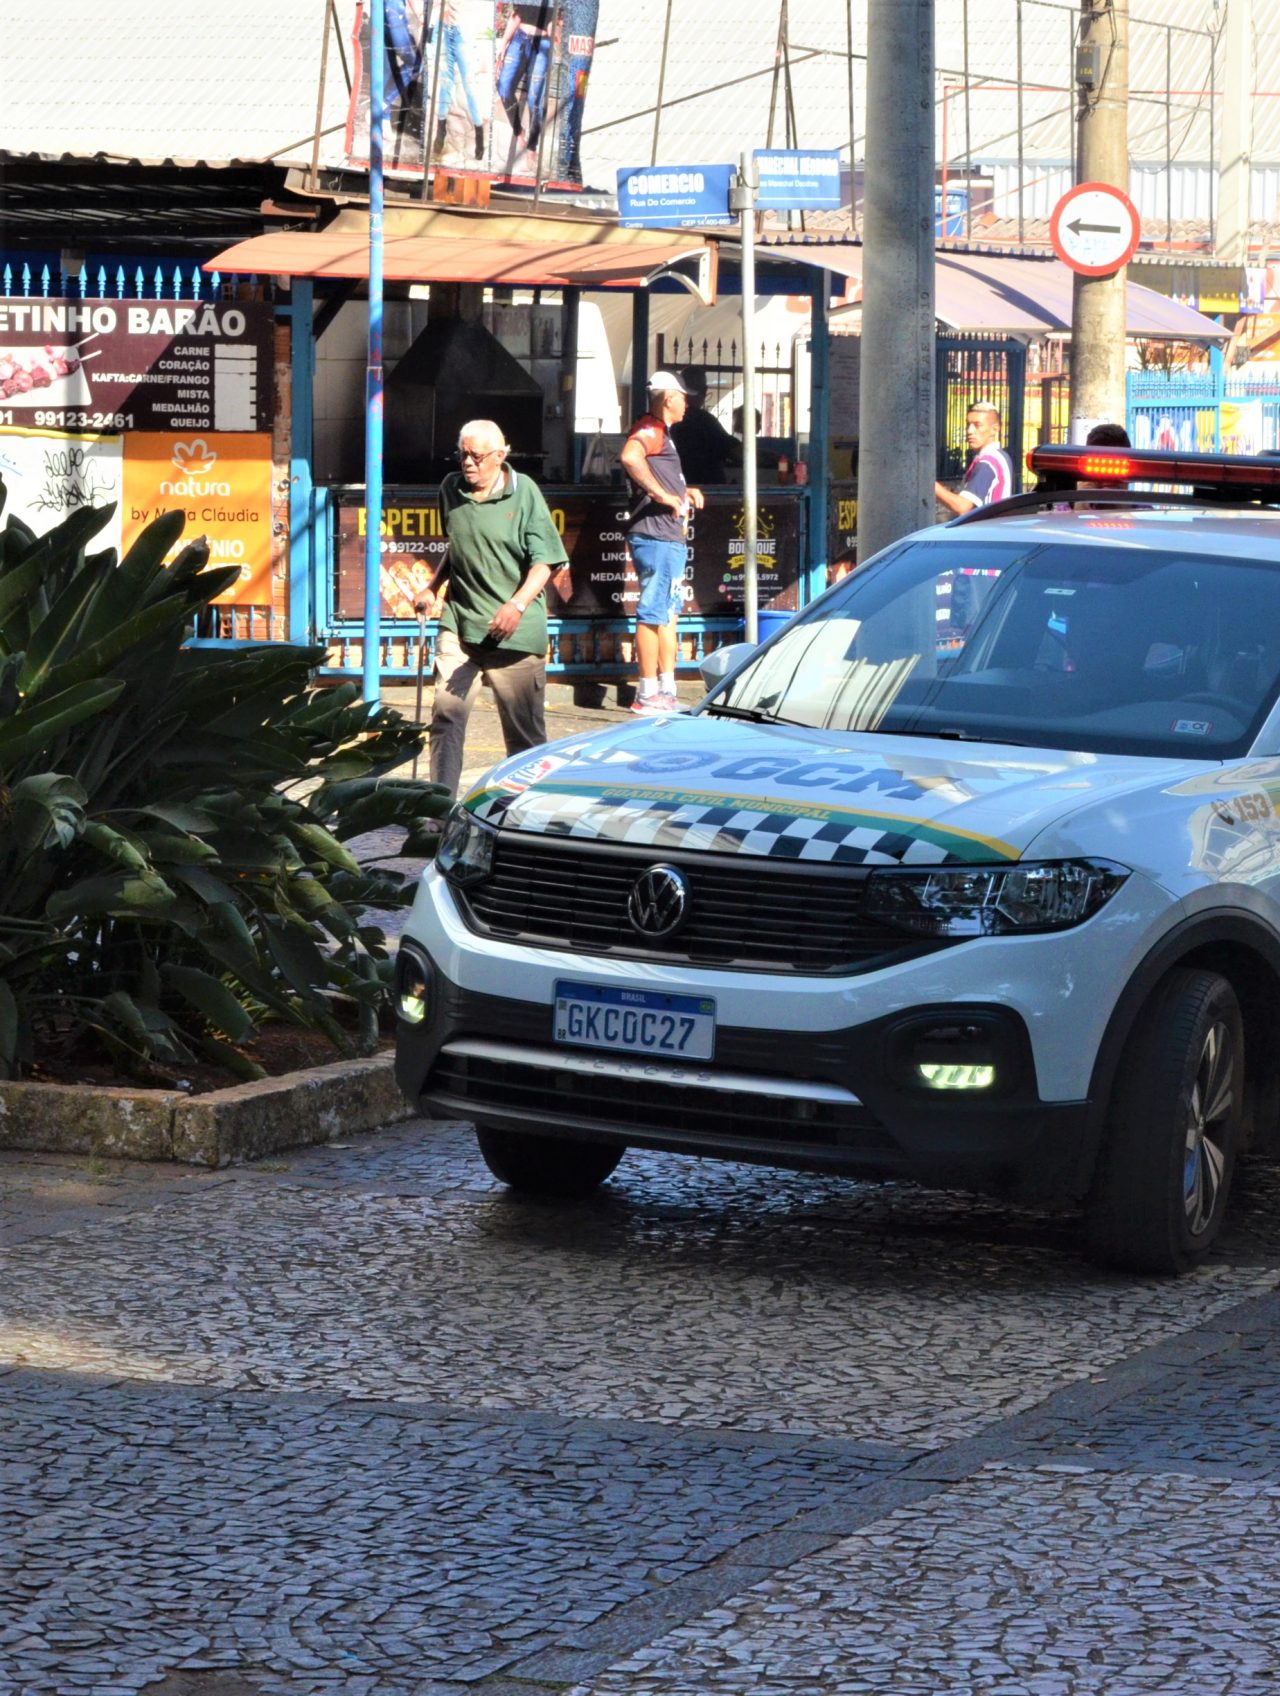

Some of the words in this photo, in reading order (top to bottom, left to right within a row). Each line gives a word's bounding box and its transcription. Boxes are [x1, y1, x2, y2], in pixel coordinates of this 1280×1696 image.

[627, 173, 704, 195] COMERCIO
[630, 199, 646, 207] Rua
[660, 197, 696, 206] Comercio
[127, 304, 246, 336] BARÃO
[174, 346, 210, 356] CARNE
[159, 360, 210, 372] CORAÇÃO
[177, 389, 210, 399] MISTA
[152, 402, 210, 413] MEDALHÃO
[35, 411, 134, 428] 99123-2461
[170, 418, 210, 428] QUEIJO
[159, 477, 231, 497] natura
[131, 507, 149, 521] by
[155, 507, 196, 521] Mia
[201, 506, 260, 522] Cláudia
[710, 756, 932, 801] GCM
[601, 788, 675, 800] GUARDA
[678, 793, 726, 806] CIVIL
[728, 798, 832, 820] MUNICIPAL
[1233, 793, 1271, 823] 153
[620, 991, 647, 1003] BRASIL
